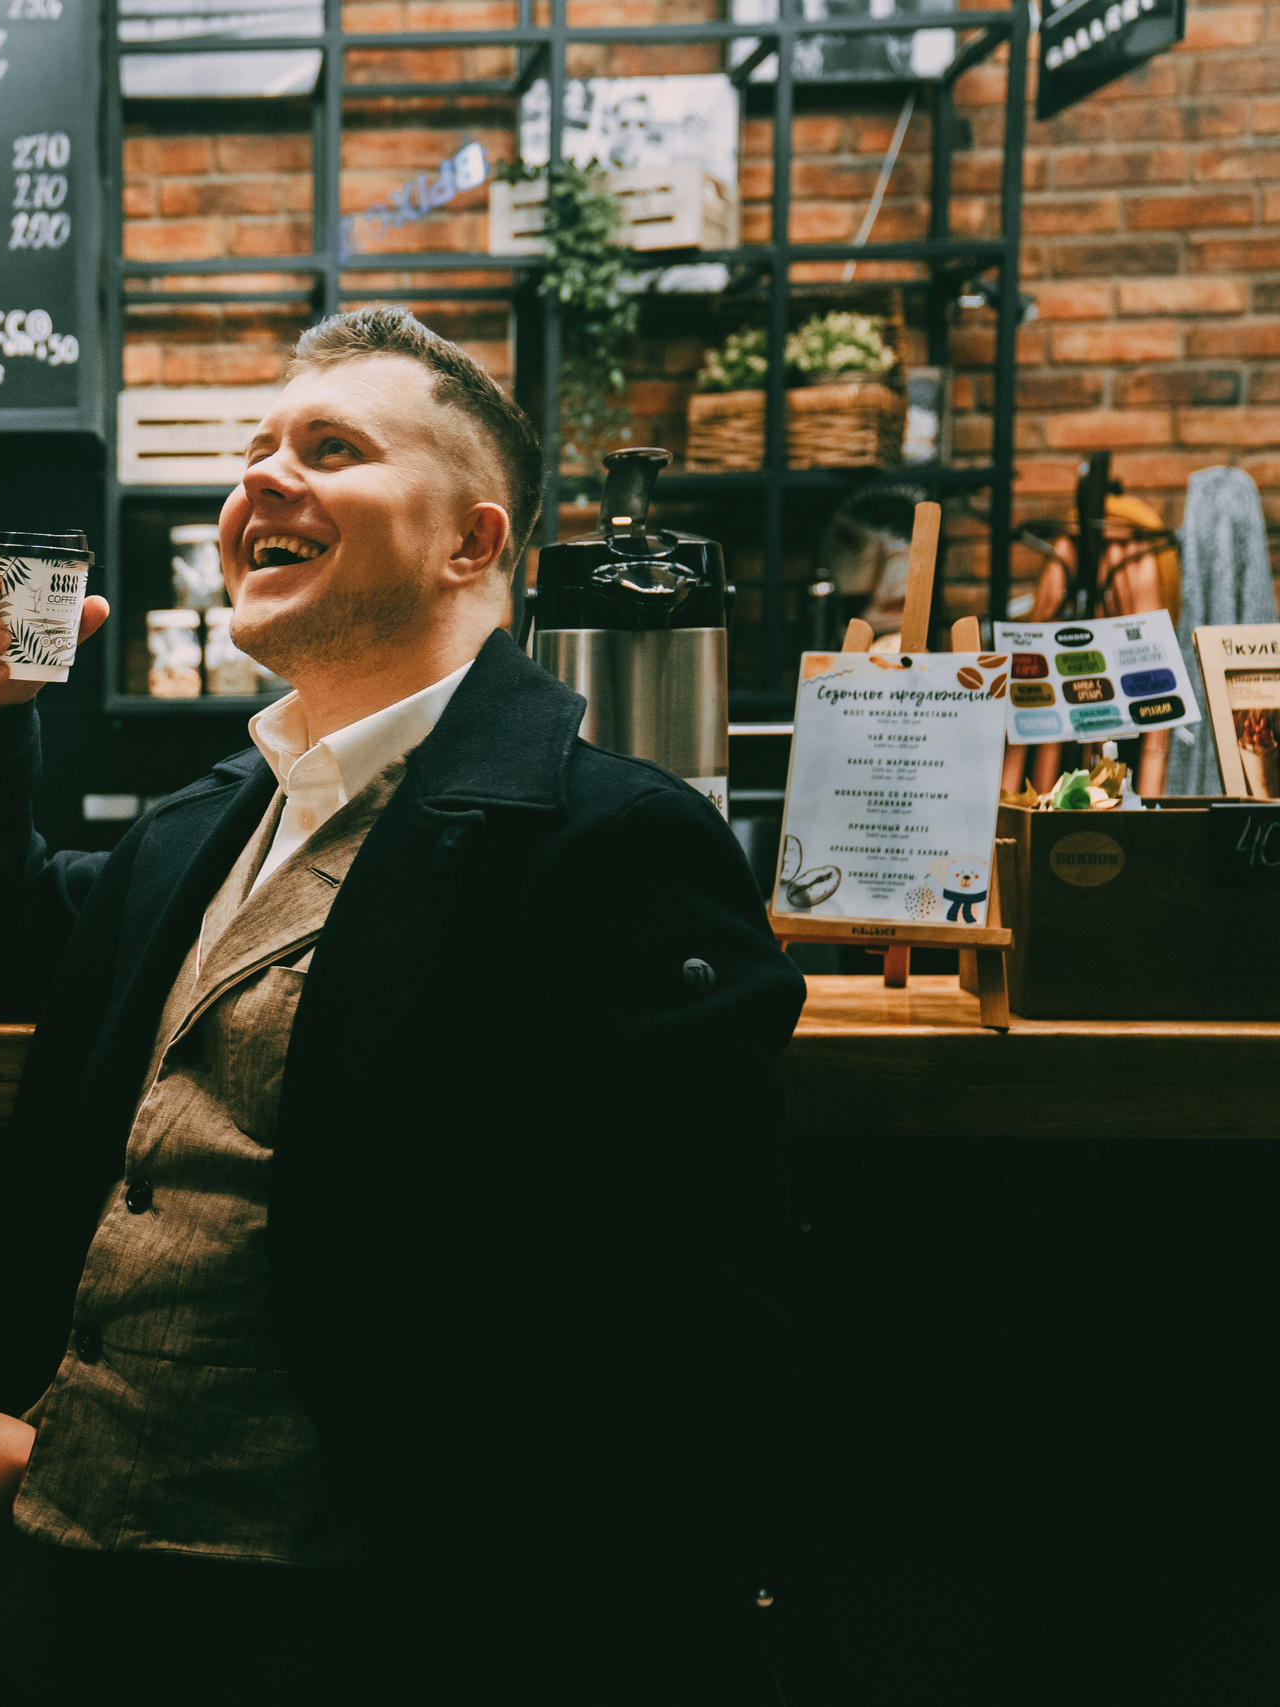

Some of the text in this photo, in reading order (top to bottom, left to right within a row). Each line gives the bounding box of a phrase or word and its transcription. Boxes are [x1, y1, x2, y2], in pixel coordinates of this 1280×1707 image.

[49, 572, 80, 594] 888
[47, 594, 78, 605] COFFEE
[1056, 633, 1092, 643] BONBON
[817, 685, 883, 706] Сезонное
[890, 688, 993, 707] предложение
[843, 709, 865, 717] ФЛЭТ
[867, 734, 928, 742] ЧАЙ ЯГОДНЫЙ
[847, 758, 874, 766] КАКАО
[886, 759, 945, 768] МАРШМЕЛЛОУ
[834, 789, 885, 798] МОККАЧИНО
[903, 791, 949, 800] ВЗБИТЫМИ
[867, 799, 913, 808] СЛИВКАМИ
[847, 822, 930, 833] ПРЯНИЧНЫЙ ЛАТТЕ
[829, 844, 881, 854] АРАХИСОВЫЙ
[884, 846, 906, 855] КОФЕ
[917, 848, 949, 857] ХАЛВОЙ
[1055, 852, 1119, 866] BONBON
[847, 870, 879, 879] ЗИМНИЕ
